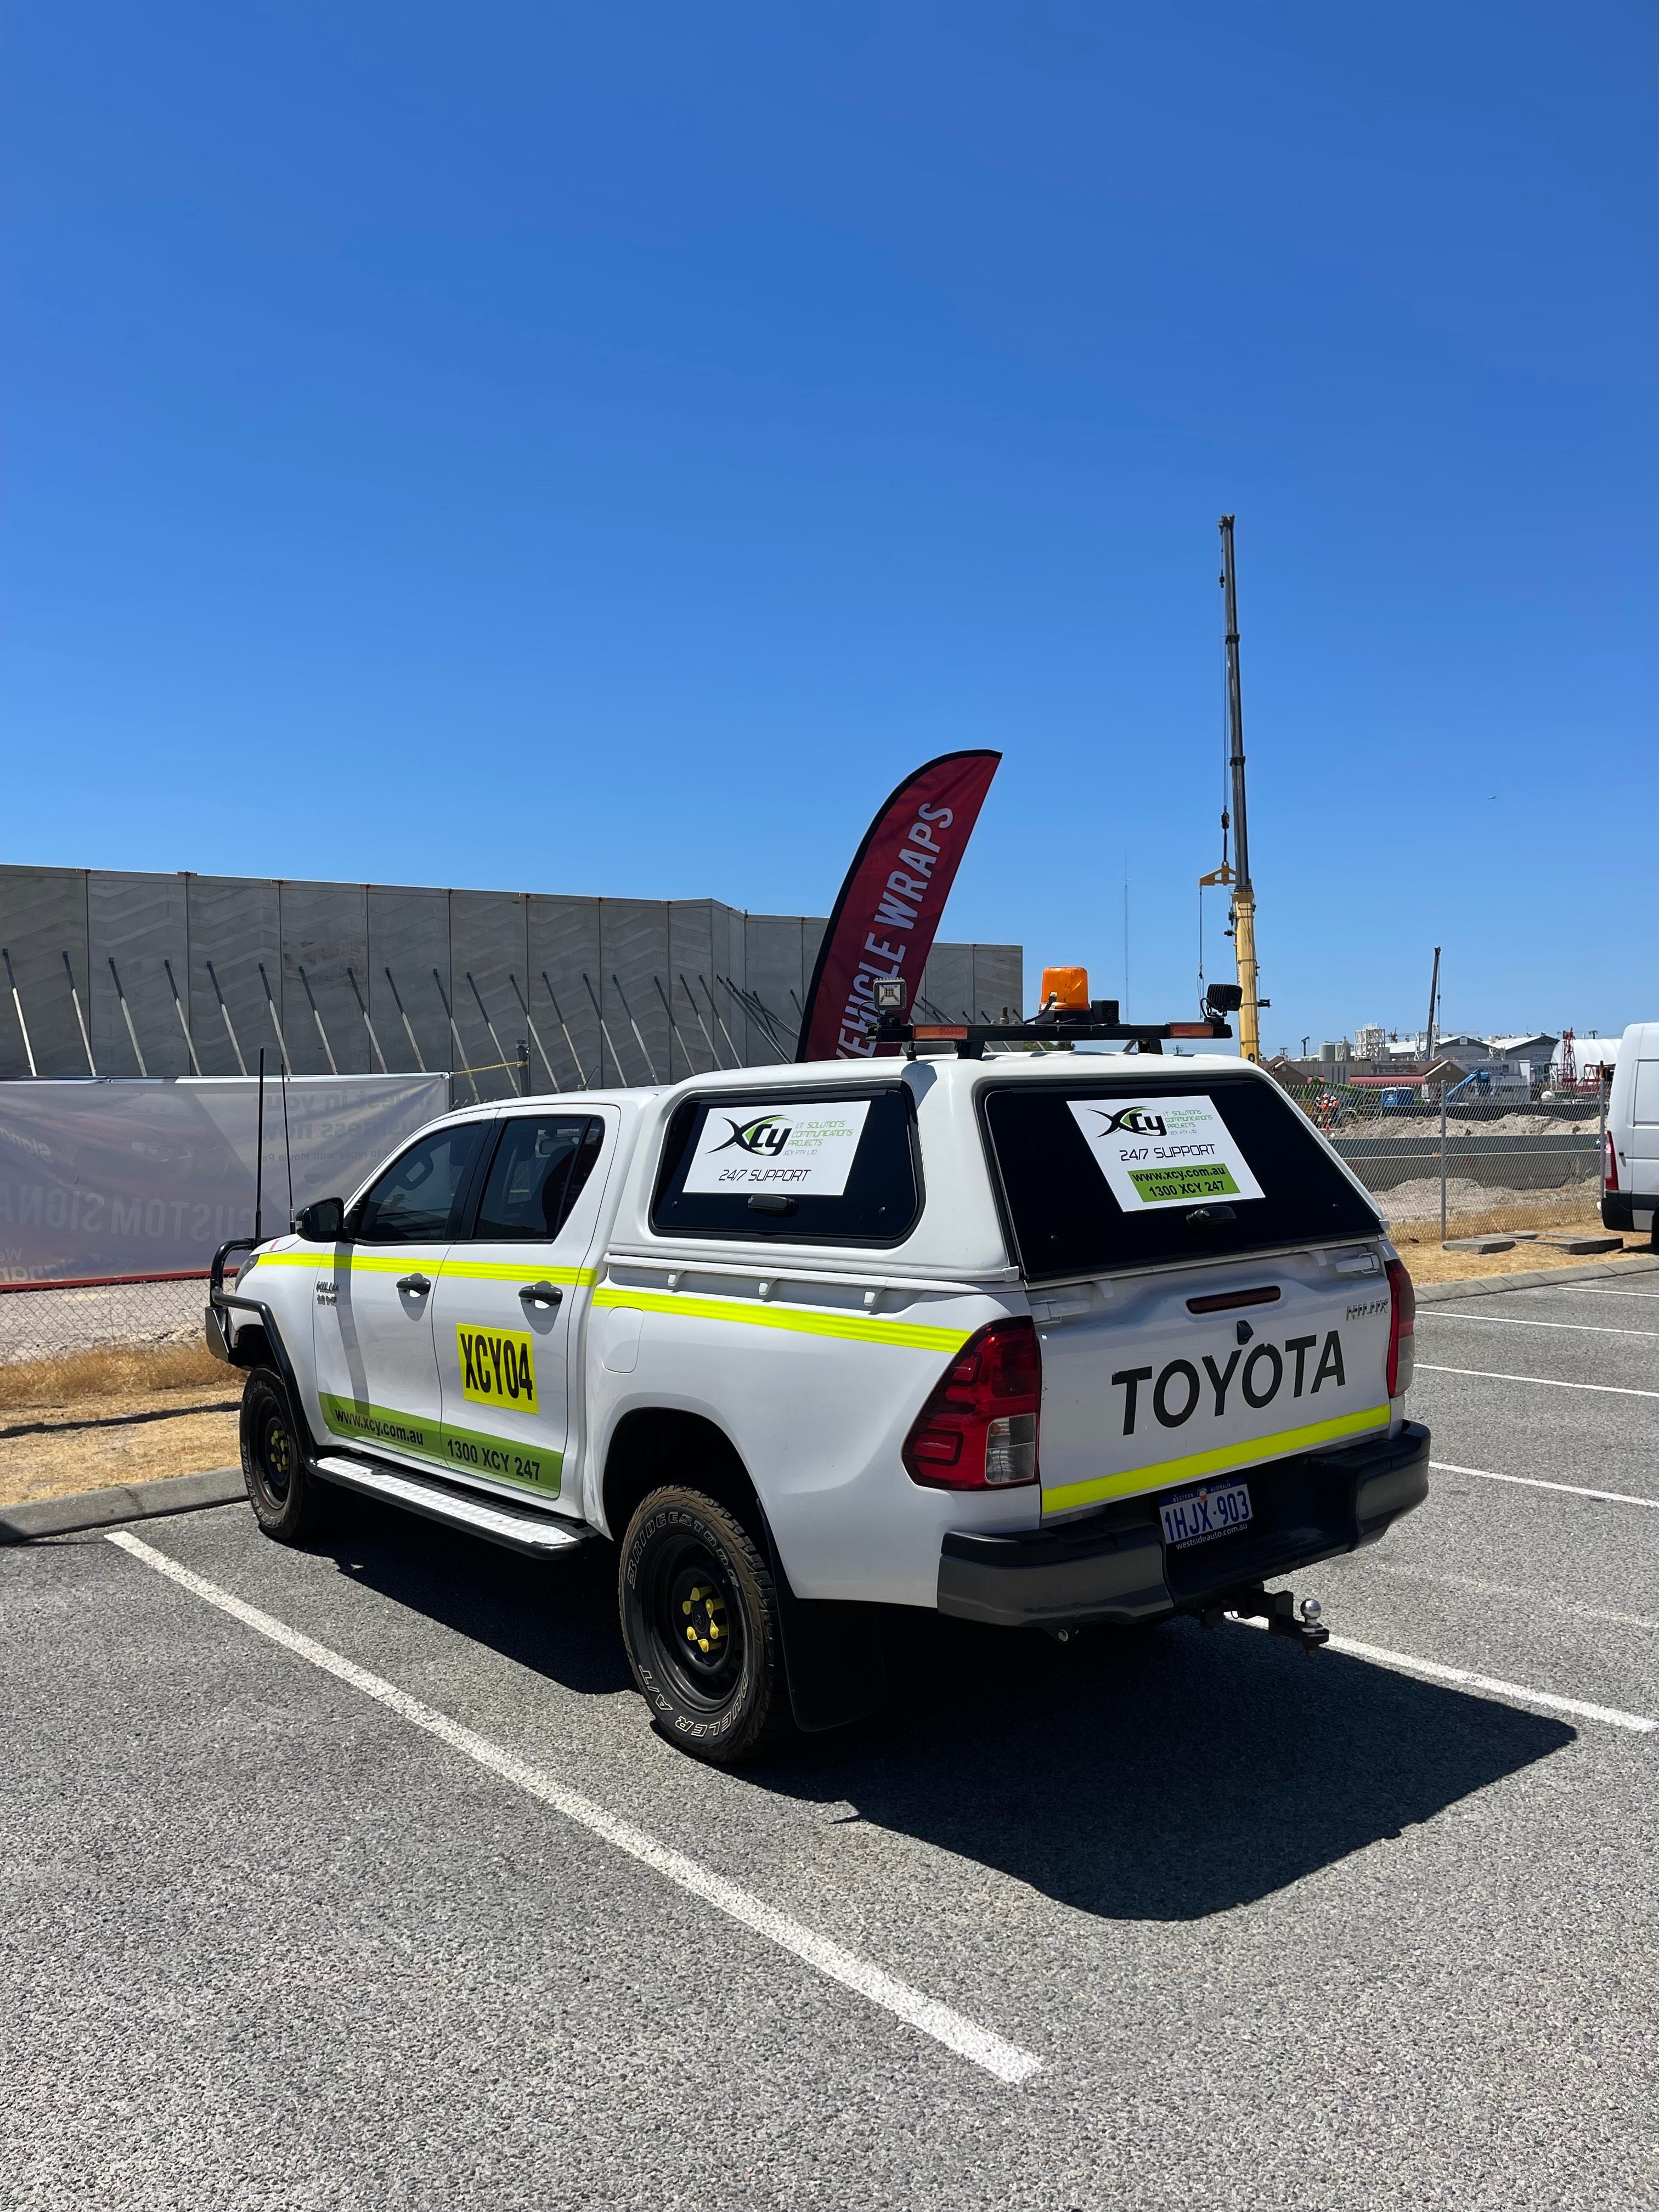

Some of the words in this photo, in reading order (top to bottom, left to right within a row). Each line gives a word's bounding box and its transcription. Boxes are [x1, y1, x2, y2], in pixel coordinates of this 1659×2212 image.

[874, 803, 953, 930] WRAPS
[791, 1129, 854, 1138] COMMUNICATIONS
[806, 1120, 846, 1128] SOLUTIONS
[1119, 1148, 1148, 1161] 24/7
[1154, 1144, 1215, 1158] SUPPORT
[718, 1169, 748, 1181] 24/7
[748, 1169, 811, 1181] SUPPORT
[1132, 1166, 1226, 1182] www.xcy.com.au
[1149, 1184, 1178, 1197] 1300
[1178, 1182, 1203, 1194] XCY
[1204, 1181, 1224, 1192] 247
[460, 1333, 533, 1401] XCY04
[1111, 1330, 1346, 1436] TOYOTA
[335, 1409, 424, 1446] www.xcy.com.au
[447, 1438, 477, 1464] 1300
[481, 1447, 510, 1472] XCY
[515, 1457, 540, 1481] 247
[1173, 1493, 1194, 1503] WESTERN
[1211, 1482, 1231, 1492] AUSTRALIA
[627, 1511, 740, 1589] BRIDGESTONE
[1176, 1523, 1248, 1550] westsideauto.com.au
[675, 1667, 749, 1738] DUELER
